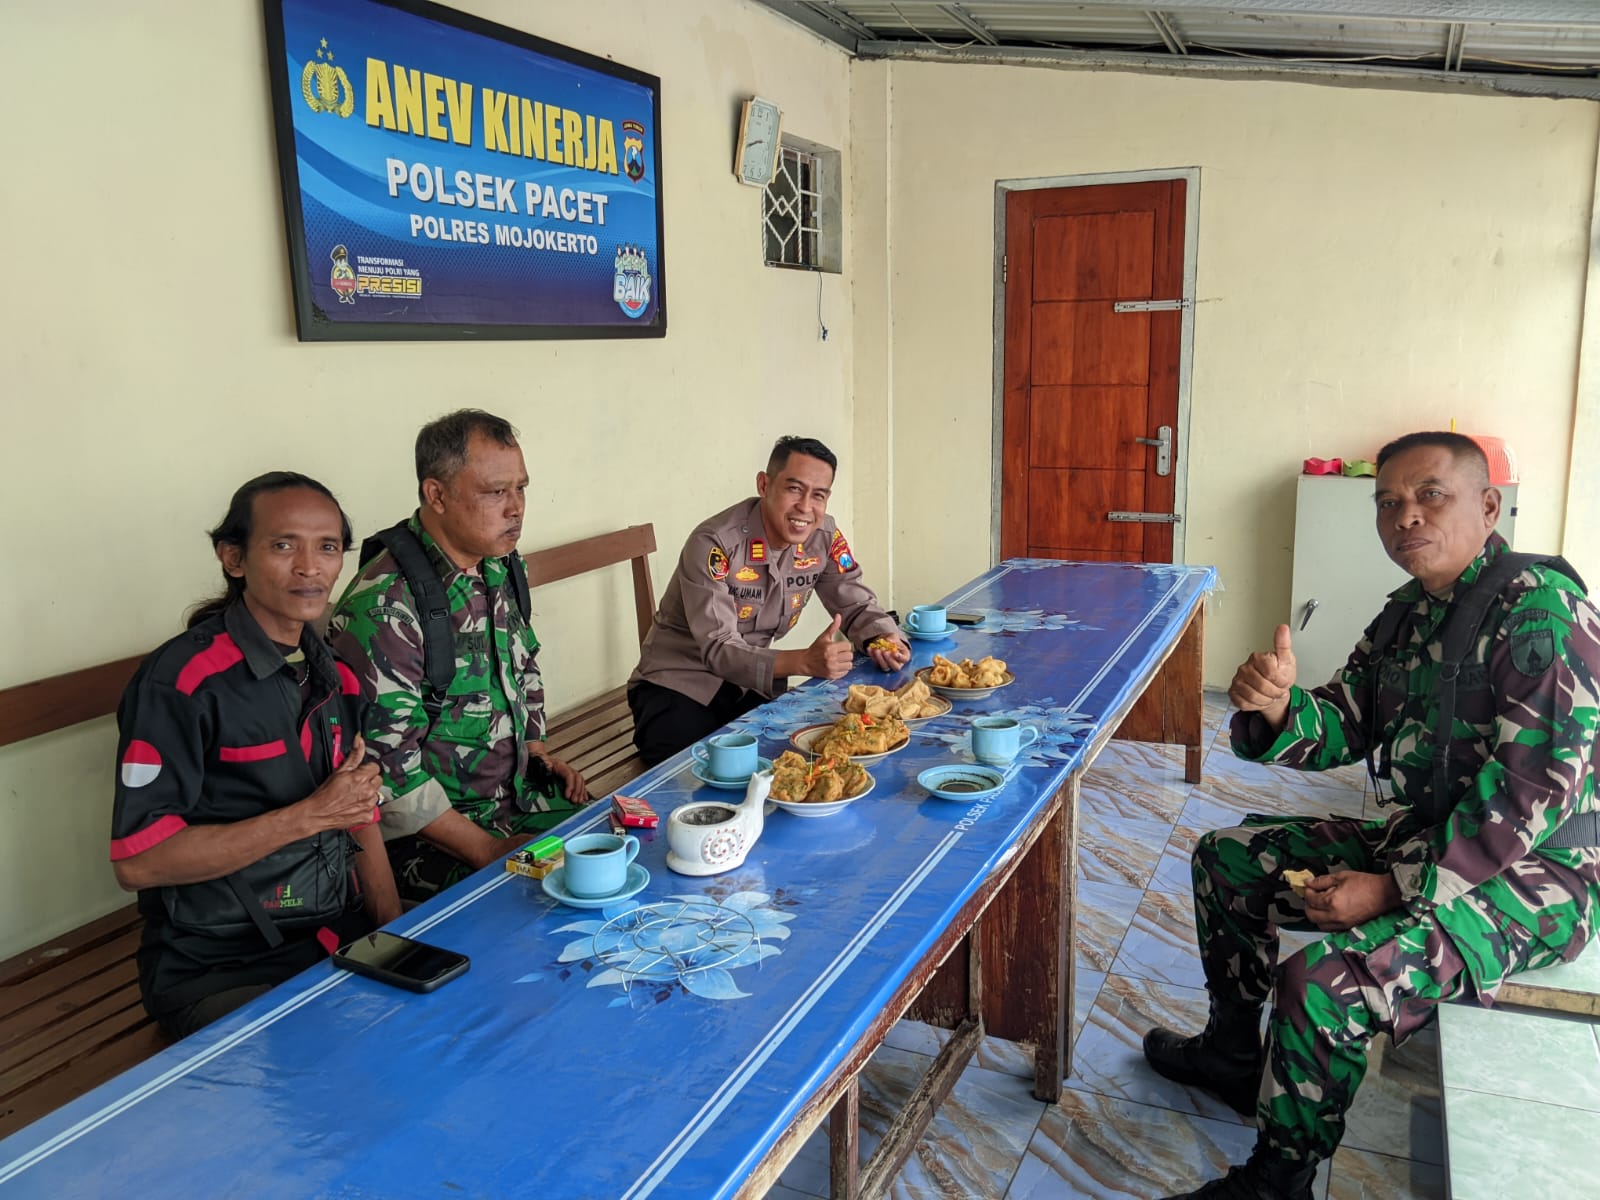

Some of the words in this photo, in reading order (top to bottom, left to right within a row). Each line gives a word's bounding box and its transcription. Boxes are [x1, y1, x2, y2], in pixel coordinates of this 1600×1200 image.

[366, 57, 473, 145] ANEV
[482, 88, 619, 175] KINERJA
[386, 158, 516, 214] POLSEK
[526, 183, 608, 226] PACET
[410, 214, 489, 244] POLRES
[495, 225, 598, 256] MOJOKERTO
[357, 256, 404, 267] TRANSFORMASI
[358, 266, 384, 275] MENUJU
[385, 267, 402, 276] POLRI
[403, 269, 420, 277] YANG
[357, 275, 422, 295] PRESISI
[614, 273, 651, 304] BAIK
[740, 587, 762, 600] UMAM
[954, 803, 991, 831] POLSEK
